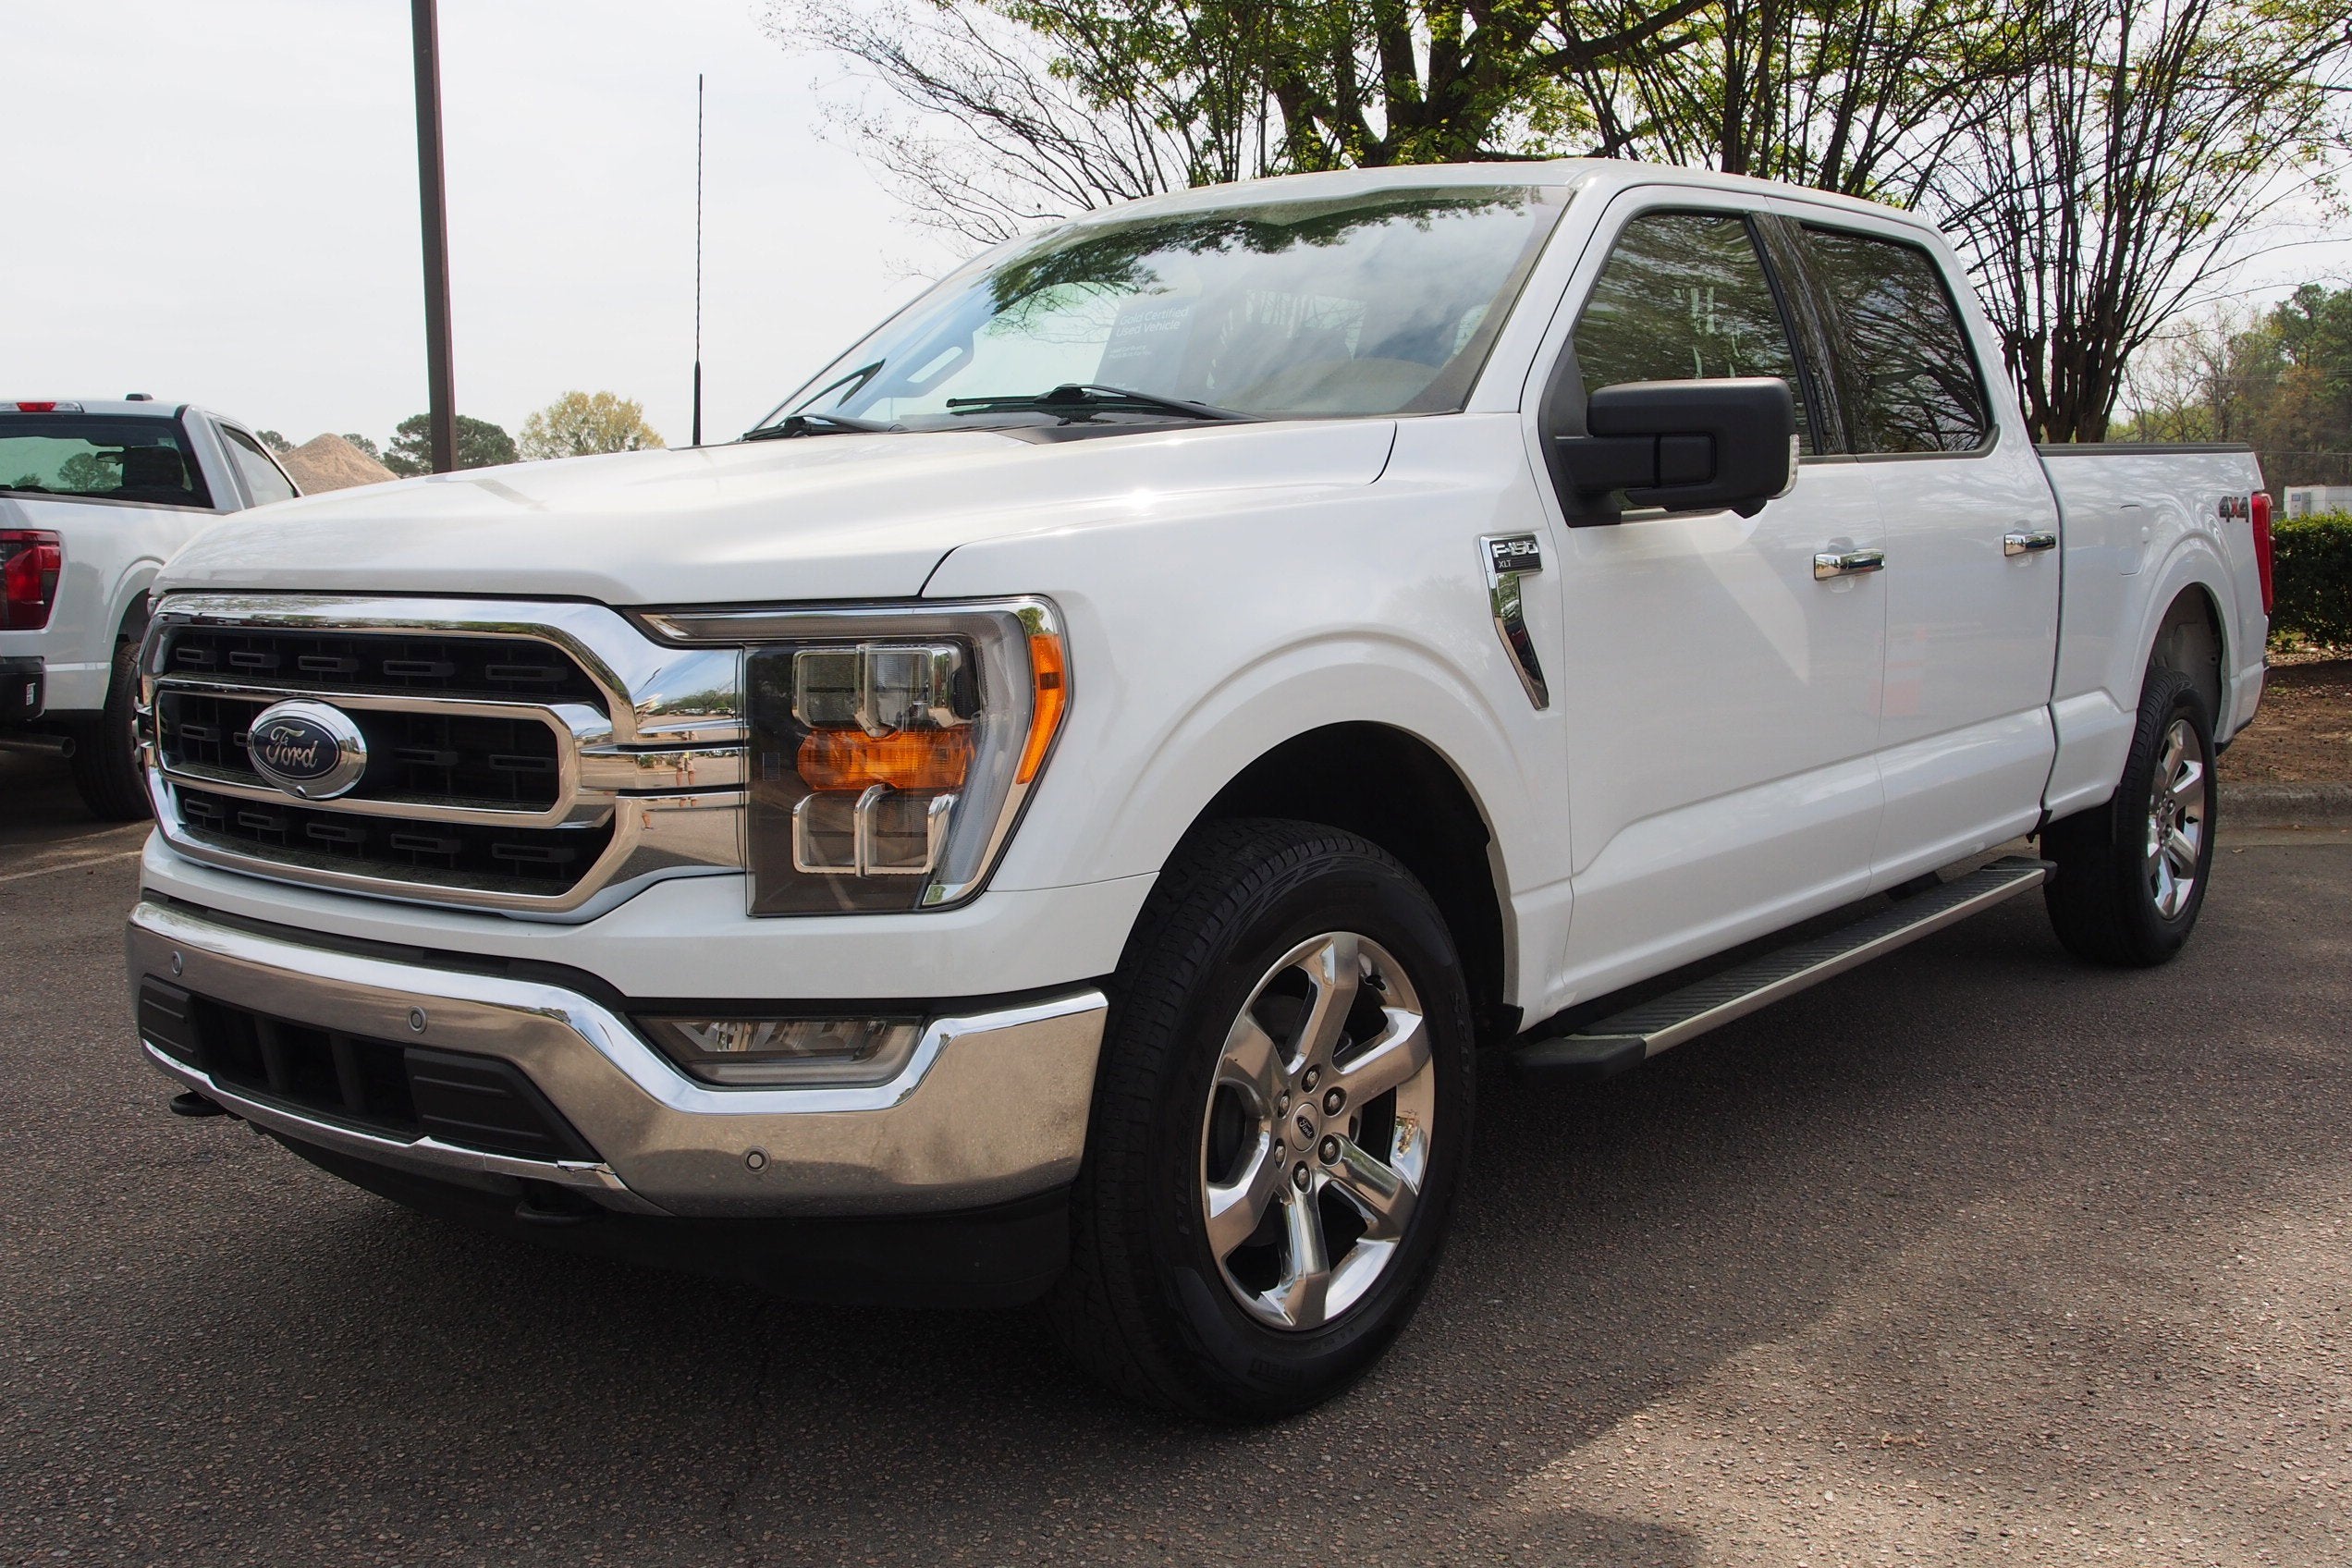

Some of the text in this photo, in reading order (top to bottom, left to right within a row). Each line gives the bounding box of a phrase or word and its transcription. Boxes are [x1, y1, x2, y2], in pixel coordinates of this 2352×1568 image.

[1120, 305, 1190, 325] Gold Certified
[1116, 319, 1181, 337] Used Vehicle
[1498, 559, 1512, 569] XLT
[265, 726, 319, 769] Ford
[1299, 1119, 1314, 1137] Ford
